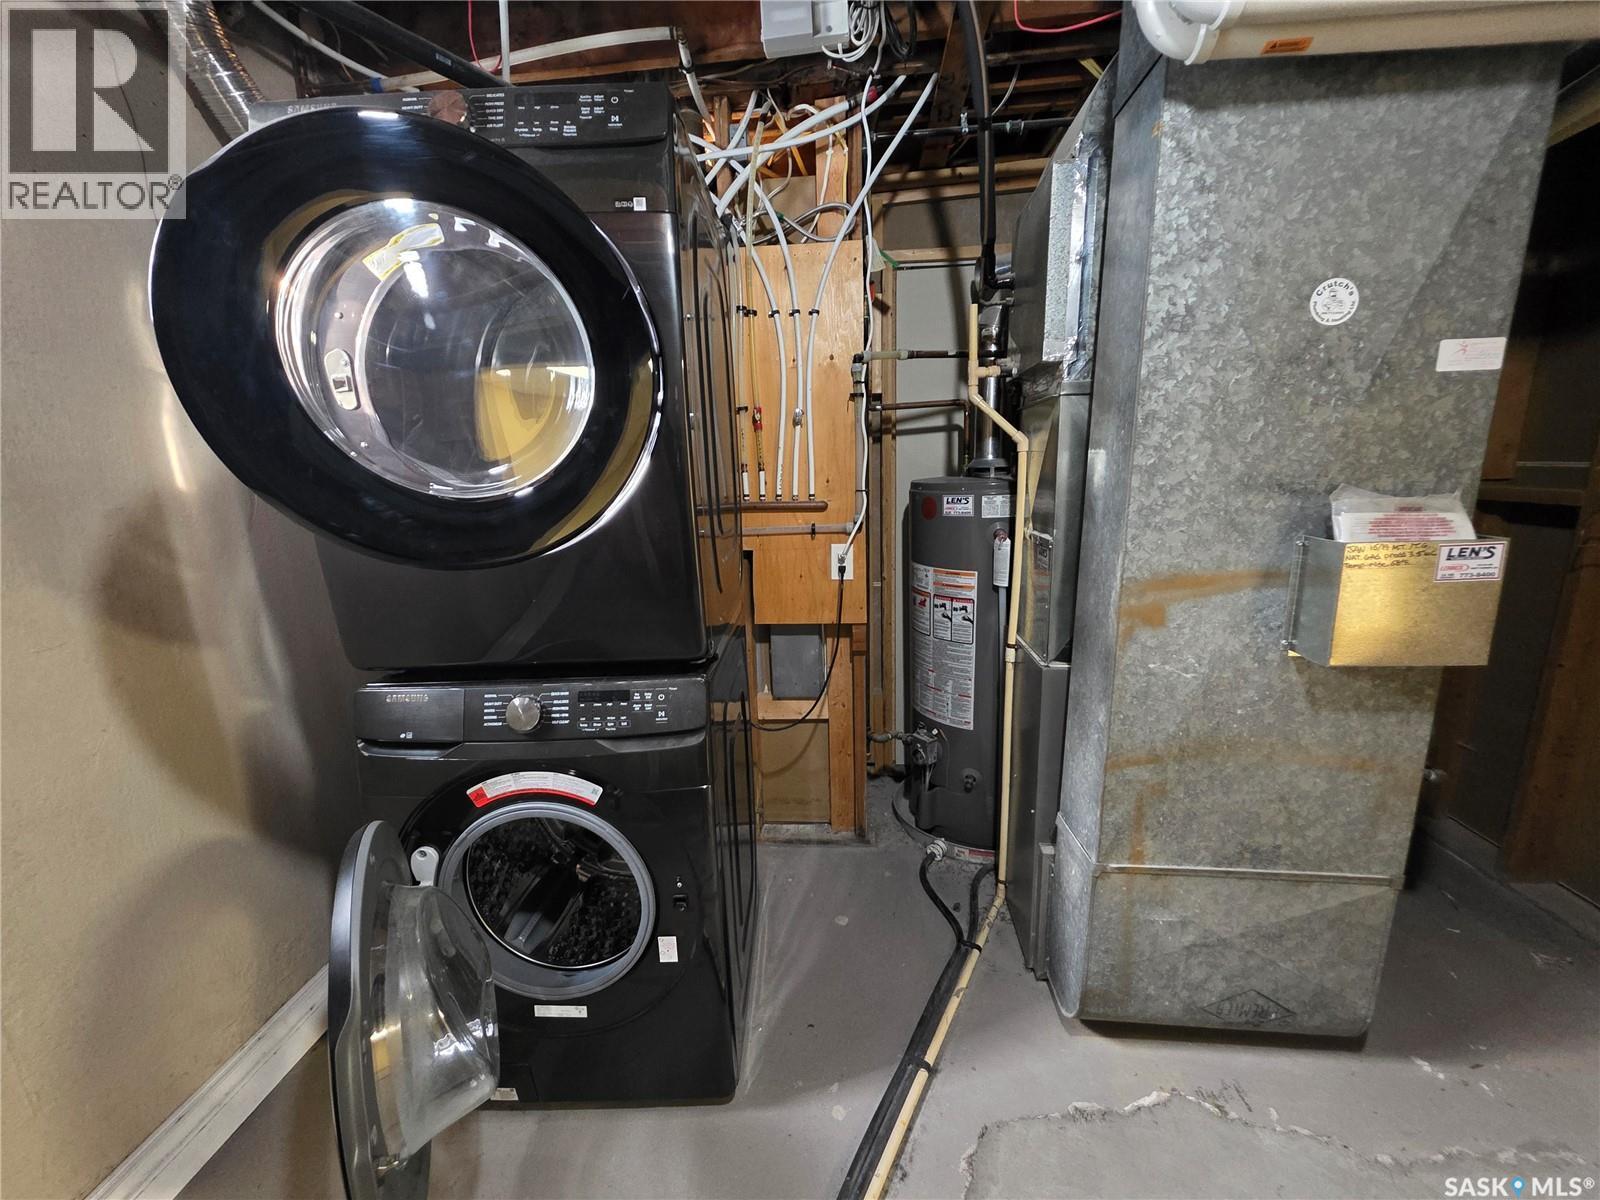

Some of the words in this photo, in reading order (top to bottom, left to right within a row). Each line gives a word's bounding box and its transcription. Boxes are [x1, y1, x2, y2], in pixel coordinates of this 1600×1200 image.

[1316, 281, 1355, 297] Crutch's
[946, 497, 970, 505] LEN'S
[1446, 546, 1497, 560] LEN'S
